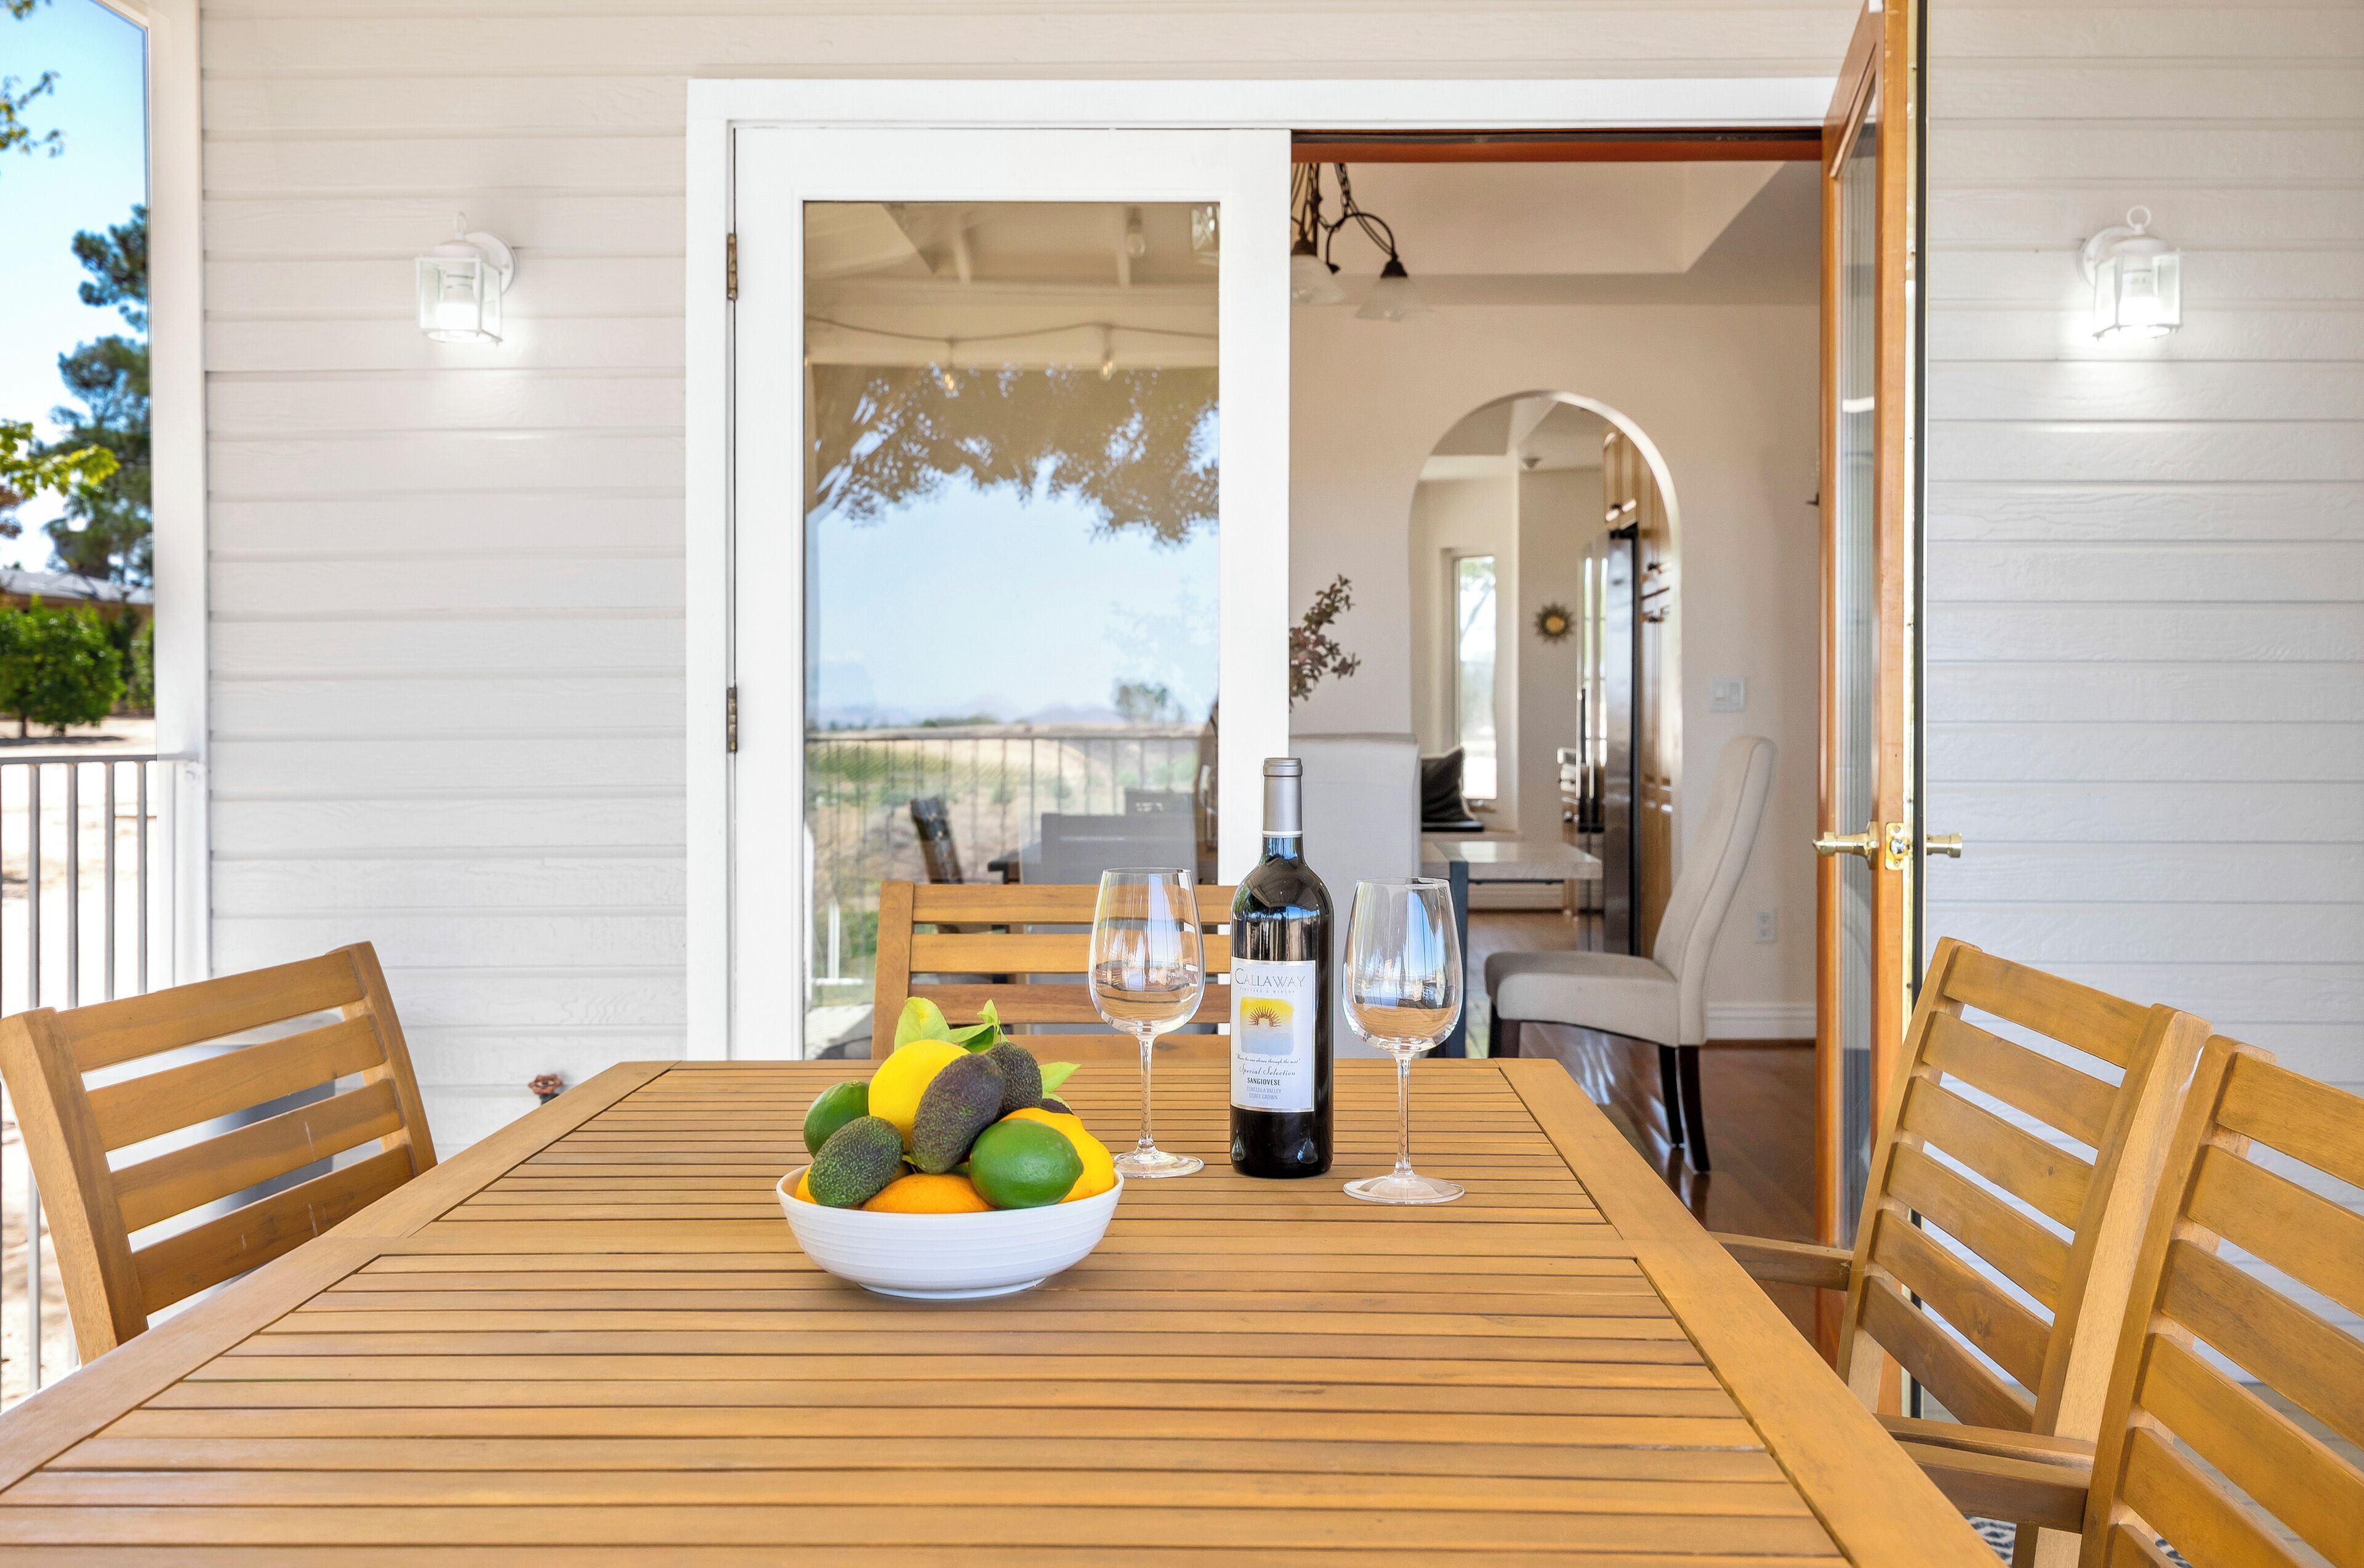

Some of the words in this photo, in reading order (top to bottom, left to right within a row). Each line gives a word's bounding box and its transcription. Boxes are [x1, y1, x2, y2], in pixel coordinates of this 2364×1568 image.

[1235, 968, 1305, 987] CALLAWAY
[1239, 1063, 1262, 1075] Special
[1263, 1066, 1296, 1076] Selection
[1247, 1077, 1281, 1086] SANGIOVESE
